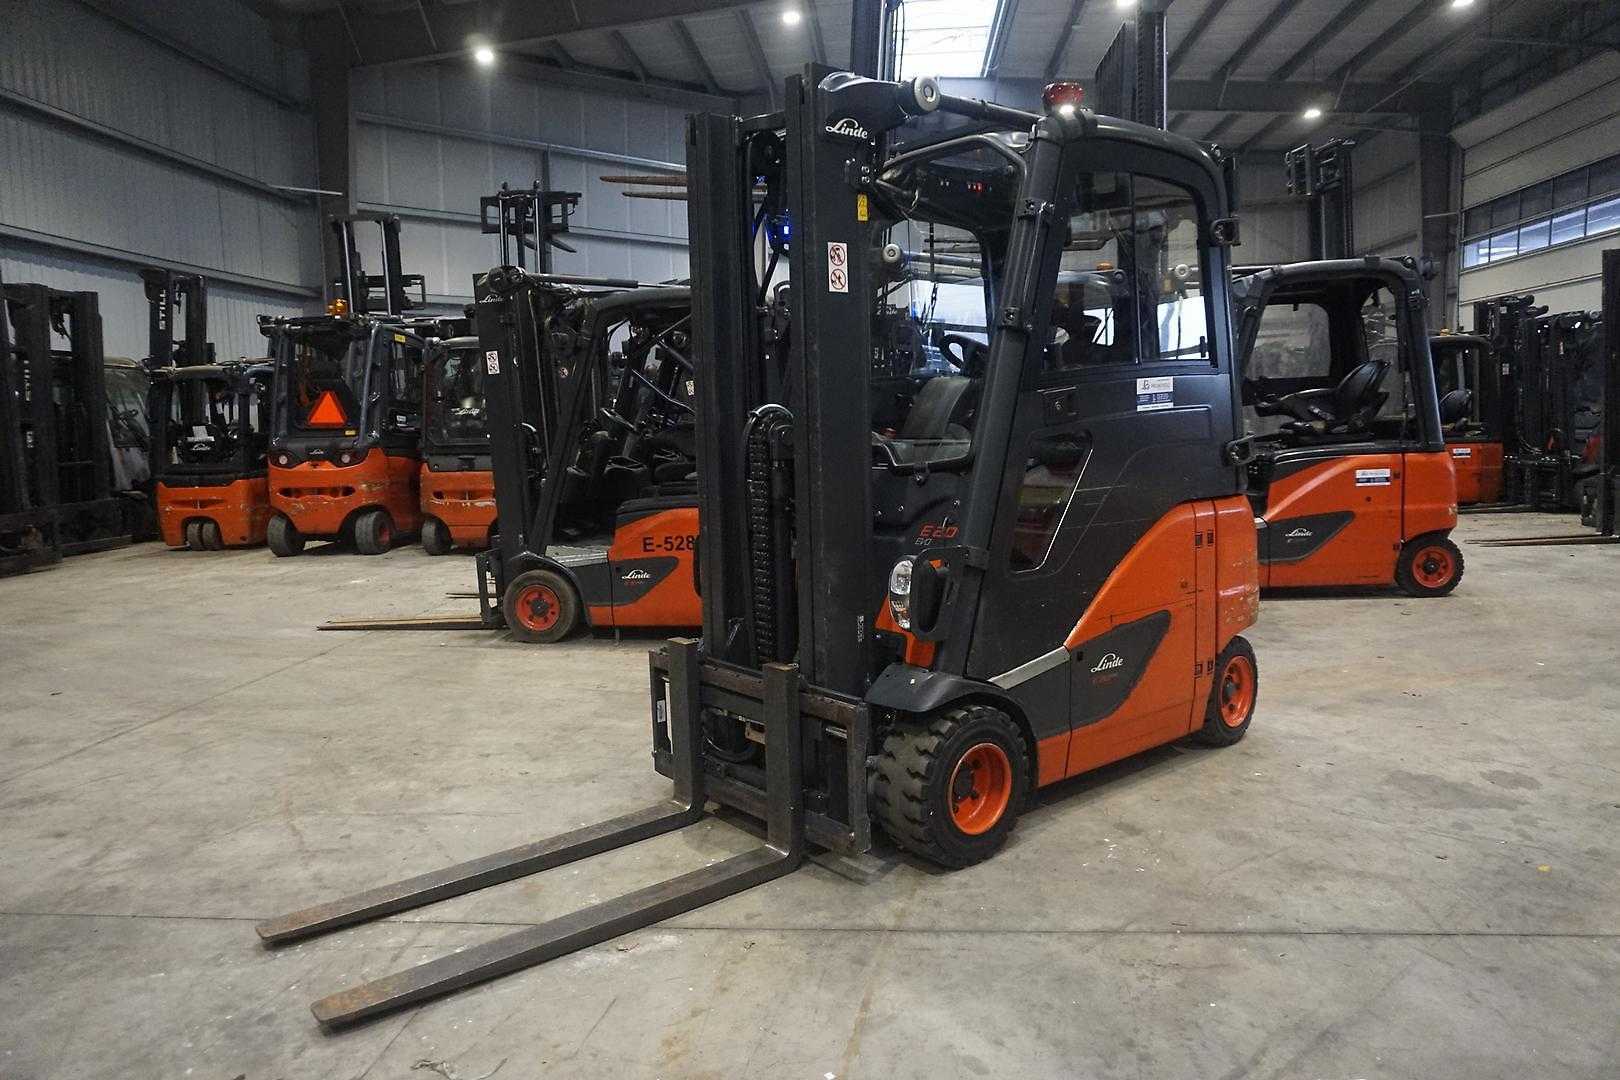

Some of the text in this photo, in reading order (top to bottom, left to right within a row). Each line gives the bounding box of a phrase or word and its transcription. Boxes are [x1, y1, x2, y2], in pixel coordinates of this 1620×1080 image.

[826, 118, 868, 139] Linde
[920, 524, 959, 538] E20
[622, 569, 652, 580] Linde
[1091, 653, 1124, 673] Linde
